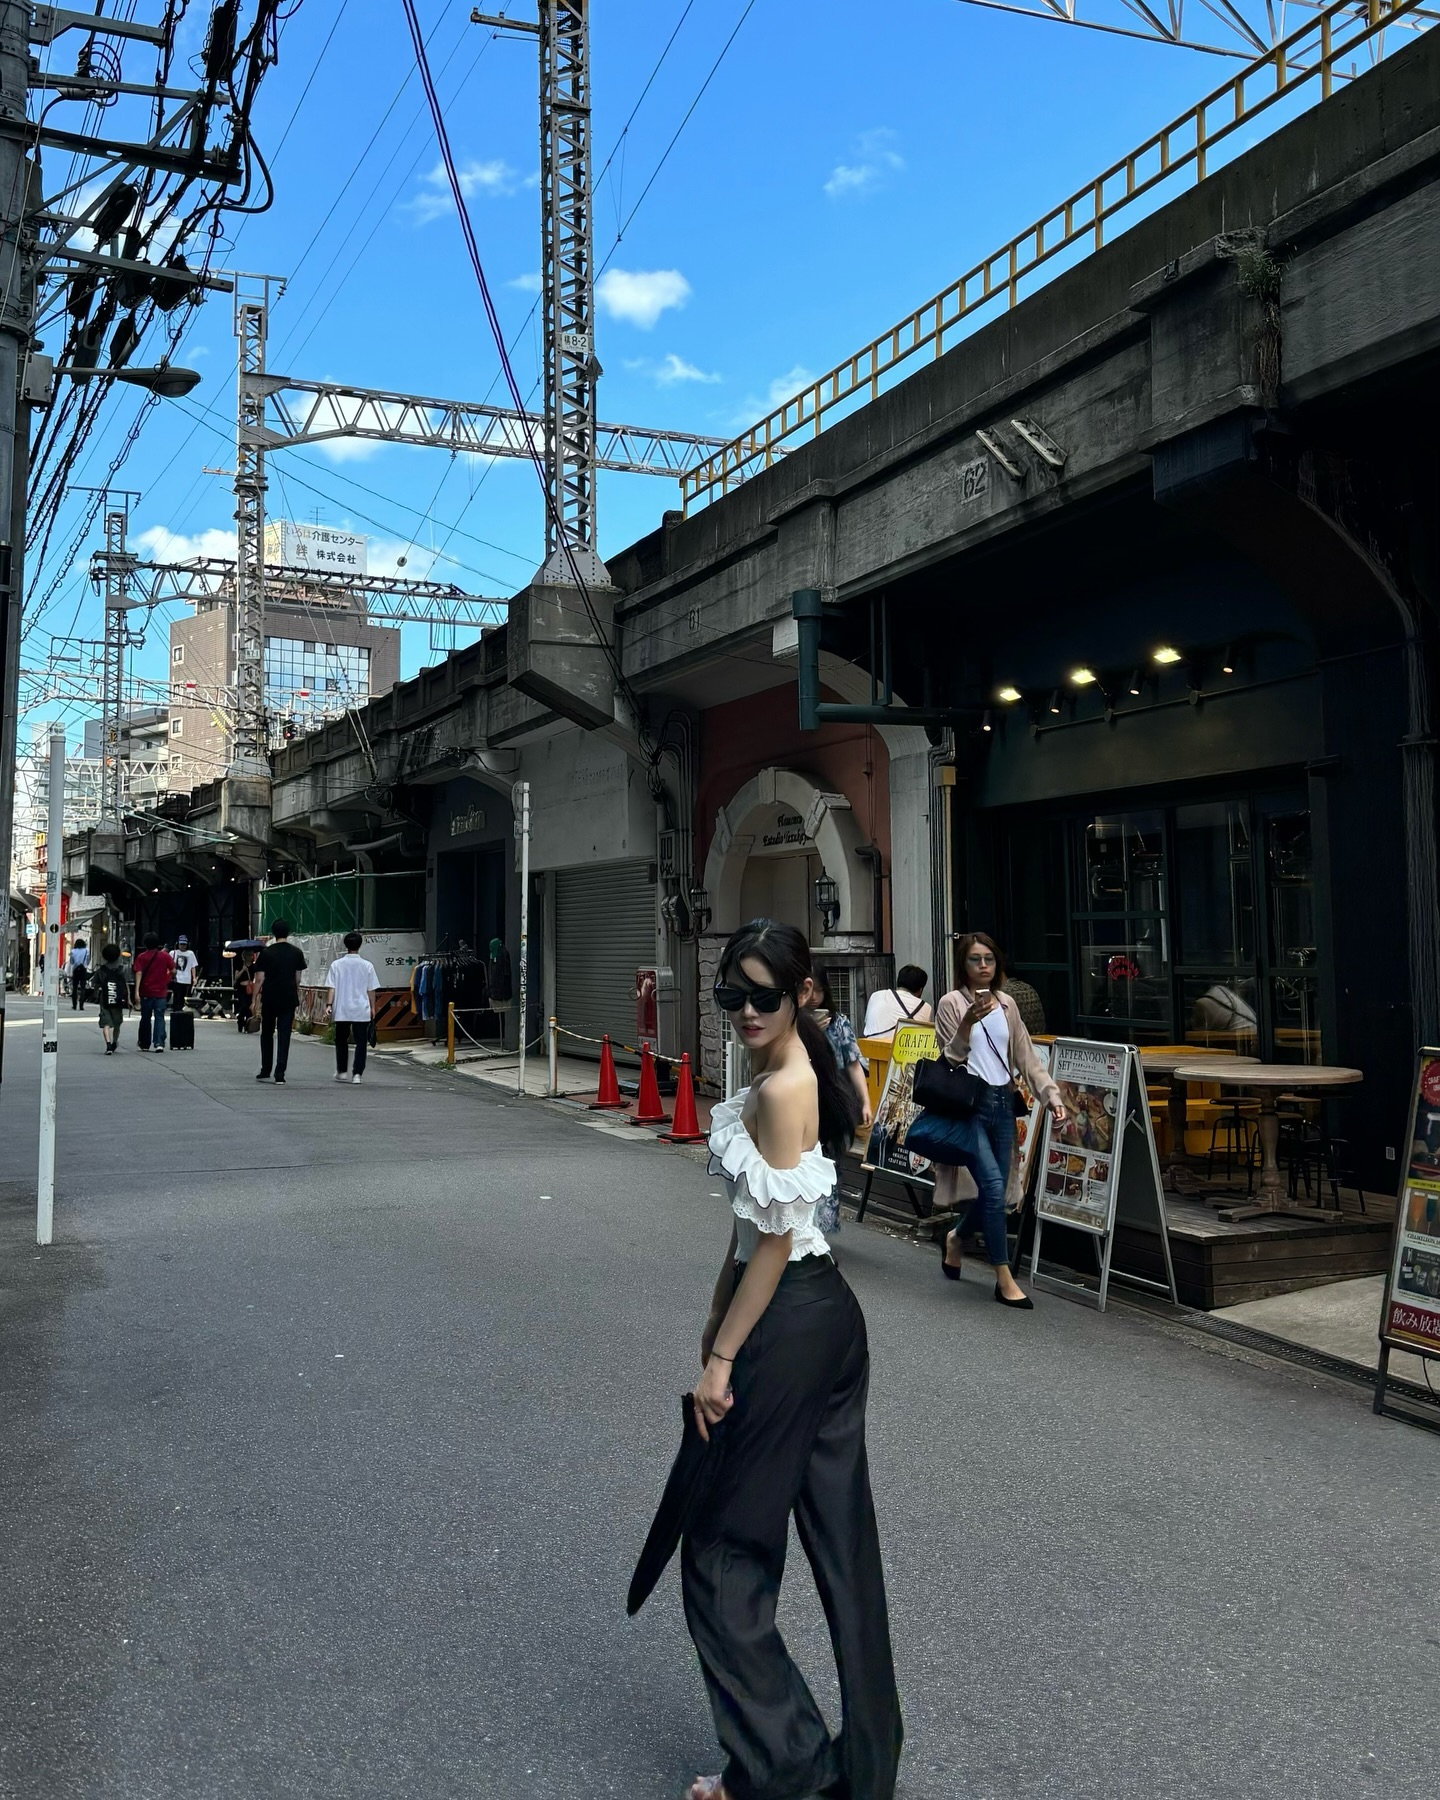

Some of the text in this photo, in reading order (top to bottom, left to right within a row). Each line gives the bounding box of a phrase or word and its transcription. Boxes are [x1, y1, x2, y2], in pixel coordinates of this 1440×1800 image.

[964, 461, 987, 498] 62
[316, 549, 357, 565] 株式会社
[385, 957, 405, 967] 安全
[107, 981, 118, 1004] PUMA
[898, 1033, 931, 1049] CRAFT
[1059, 1048, 1108, 1064] AFTERNOON
[1057, 1060, 1071, 1071] SET
